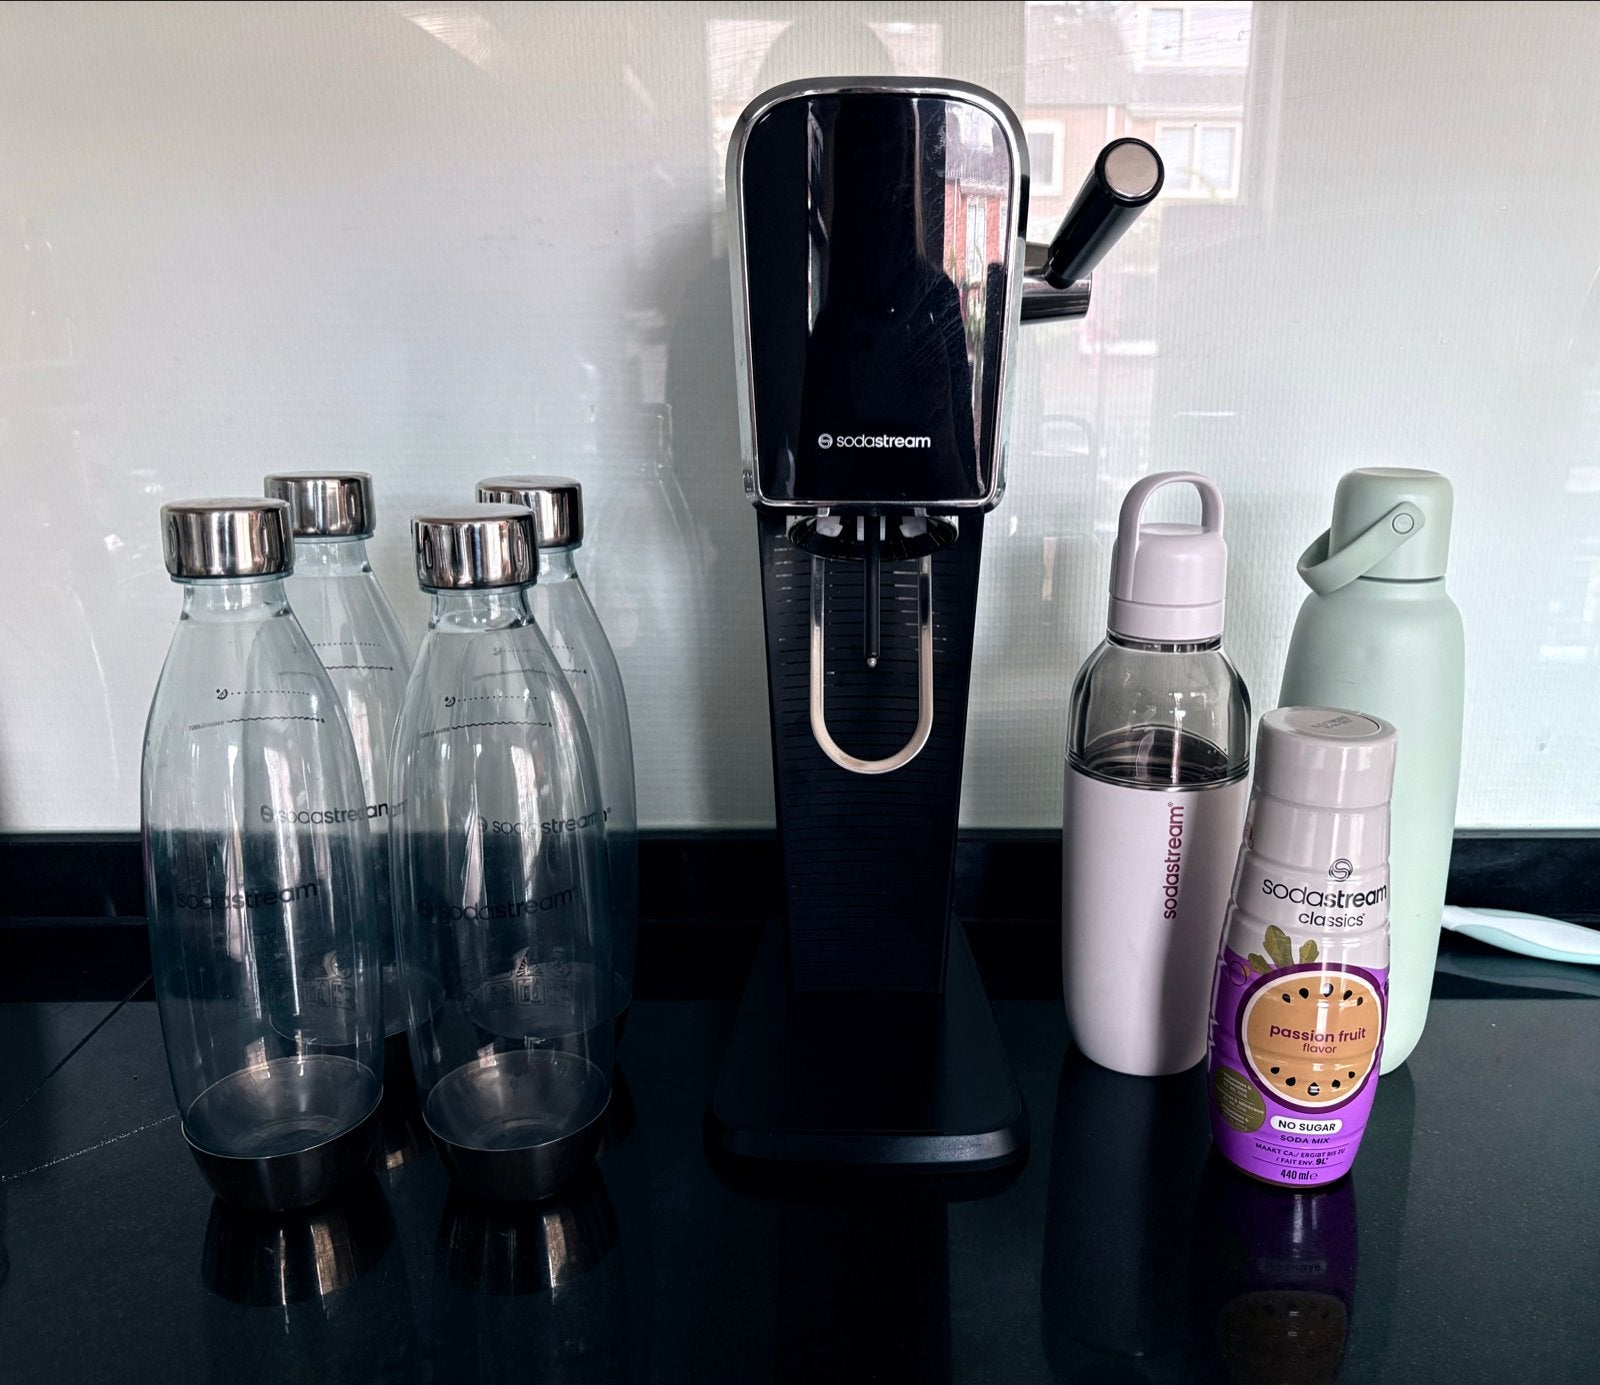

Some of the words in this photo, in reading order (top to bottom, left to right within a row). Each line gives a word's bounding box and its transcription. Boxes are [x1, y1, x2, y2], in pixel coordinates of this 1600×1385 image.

[836, 434, 931, 448] sodastream
[1262, 879, 1387, 908] sodastream
[1269, 1024, 1335, 1043] passion
[1338, 1027, 1366, 1041] fruit
[1302, 1043, 1337, 1054] flavor
[1278, 1119, 1296, 1130] NO
[1299, 1122, 1336, 1132] SUGAR
[1279, 1134, 1309, 1144] SODA
[1255, 1142, 1281, 1154] MAAKT
[1280, 1157, 1296, 1165] FAIT
[1279, 1169, 1298, 1180] 440
